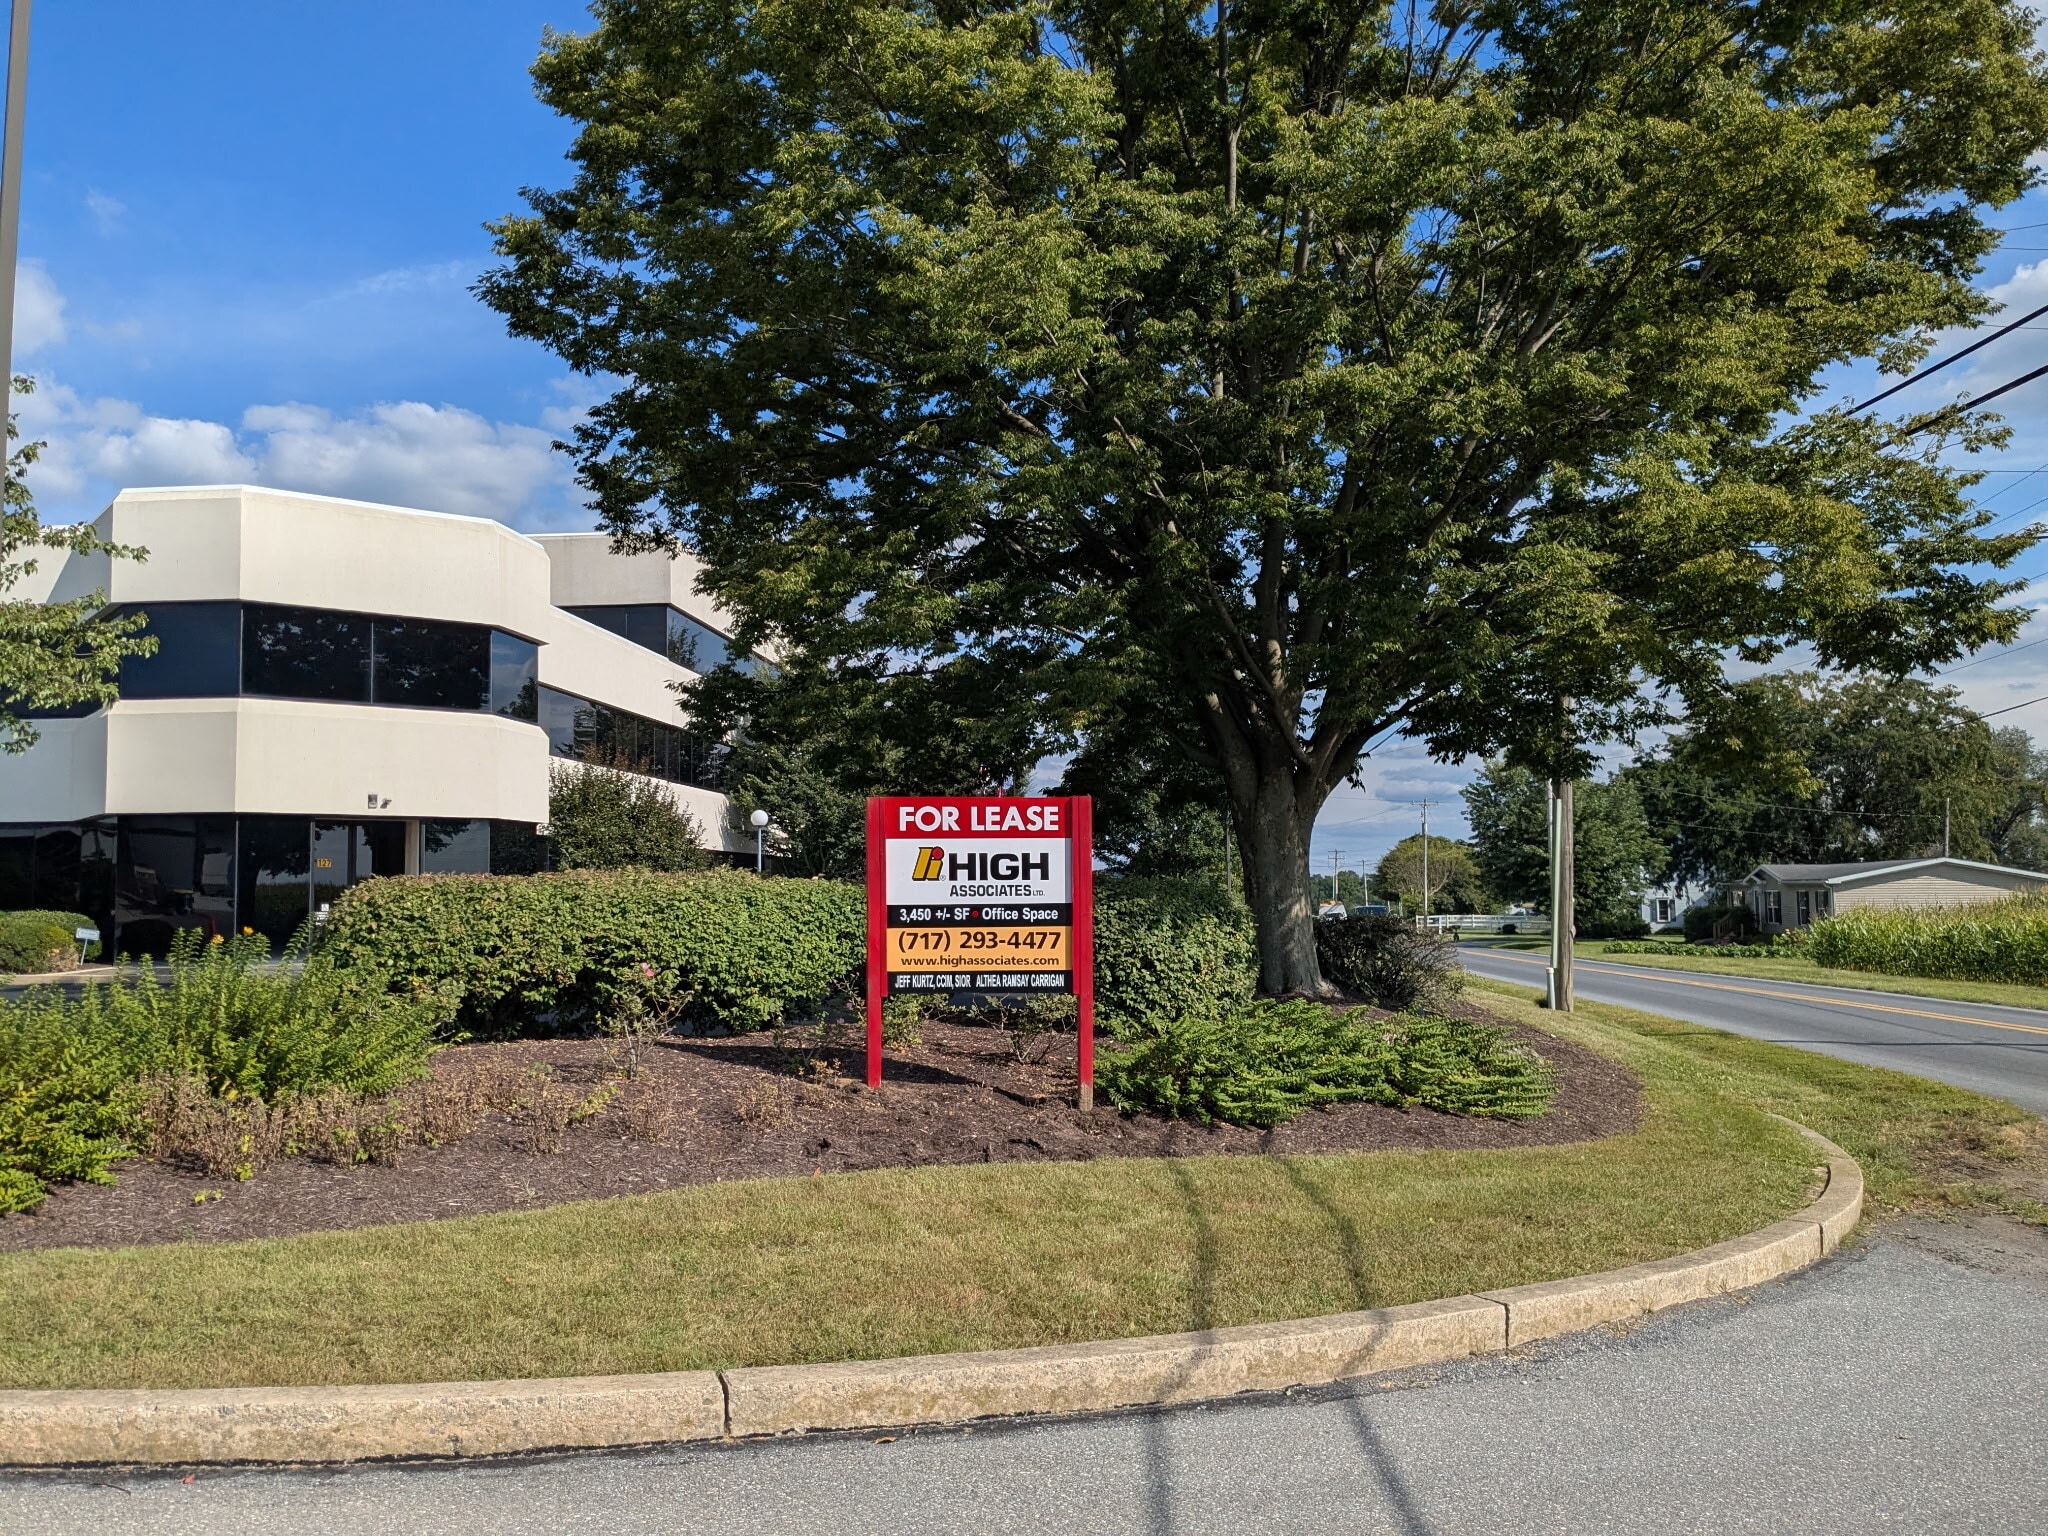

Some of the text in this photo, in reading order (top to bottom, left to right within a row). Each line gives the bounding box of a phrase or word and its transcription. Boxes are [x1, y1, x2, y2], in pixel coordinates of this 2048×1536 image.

[899, 806, 1060, 832] FOR LEASE
[948, 852, 1050, 881] HIGH
[950, 884, 1046, 897] ASSOCIATES LTD.
[899, 907, 1059, 923] 3,450 +/- SF Office Space
[898, 930, 1061, 953] (717) 293-4477
[900, 955, 1060, 967] www.highassociates.com
[895, 975, 972, 990] JEFF KURTZ, CCIM, SIOR
[975, 974, 1065, 988] ALTHEA RAMSAY CARRIGAN
